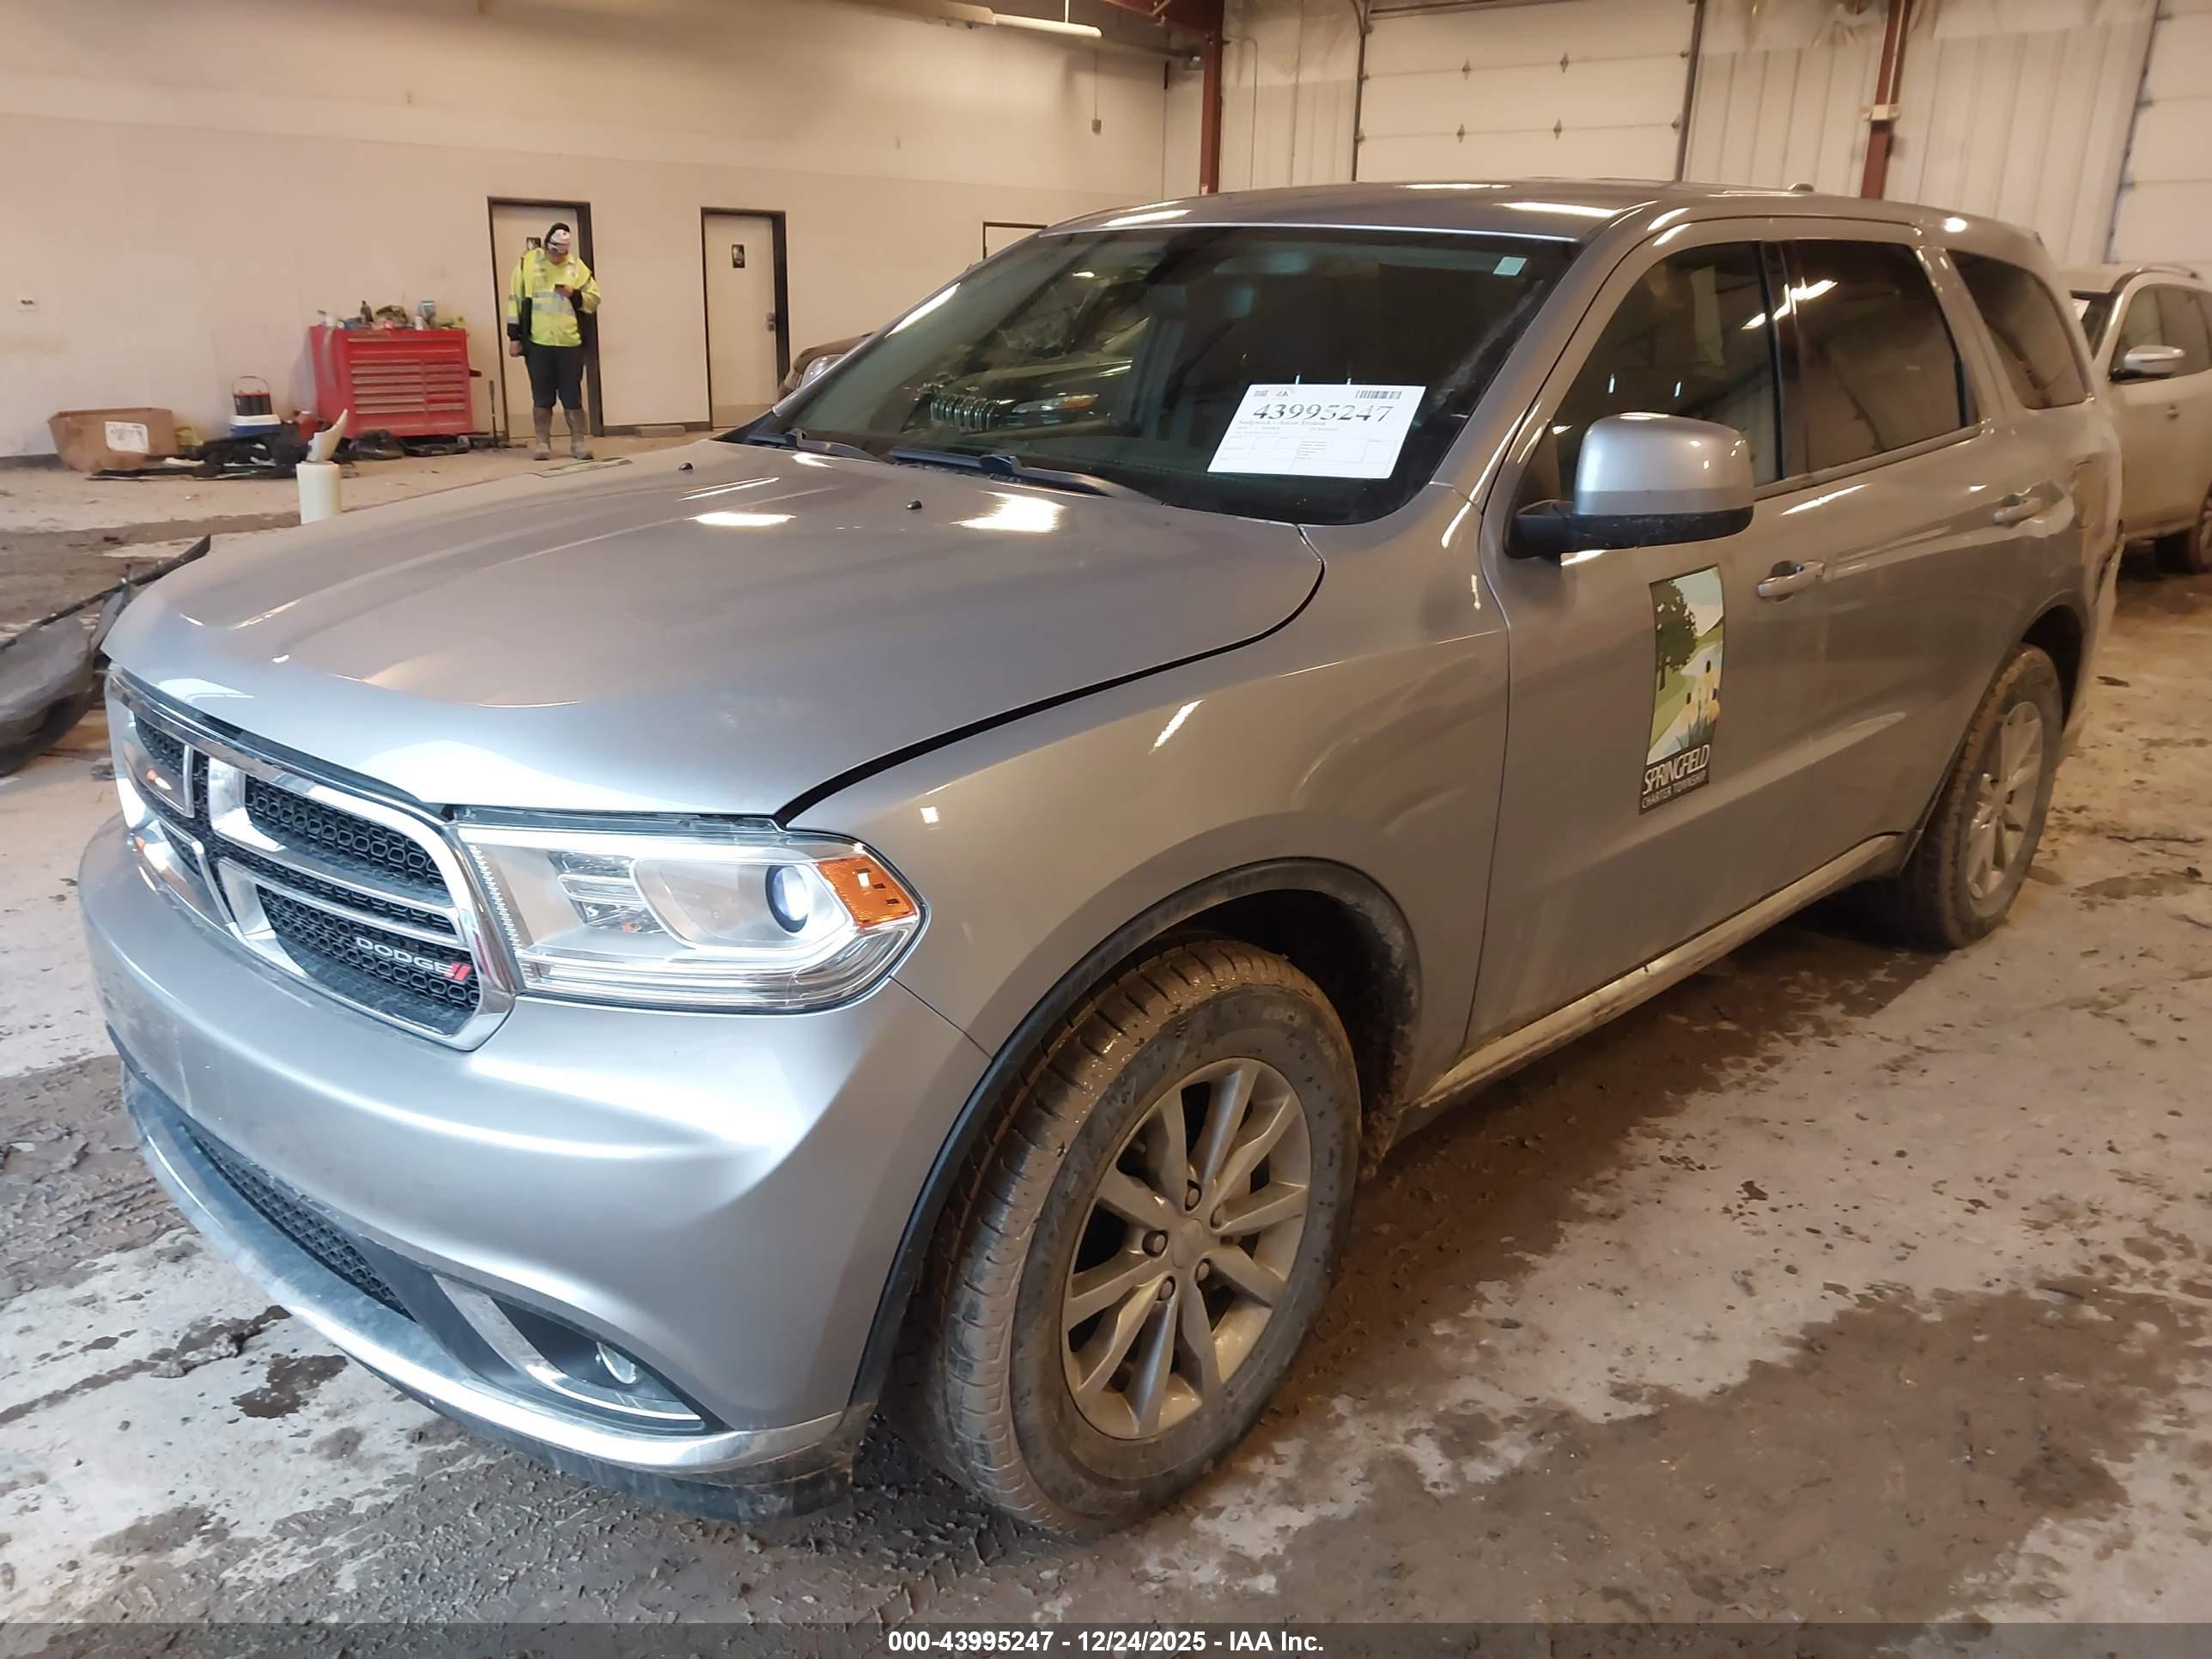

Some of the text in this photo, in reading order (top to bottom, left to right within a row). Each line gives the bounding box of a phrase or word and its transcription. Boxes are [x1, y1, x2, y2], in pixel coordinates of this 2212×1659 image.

[1253, 404, 1394, 422] 43995247
[1642, 744, 1711, 795] SPRINGFIELD
[355, 936, 454, 976] DODGE
